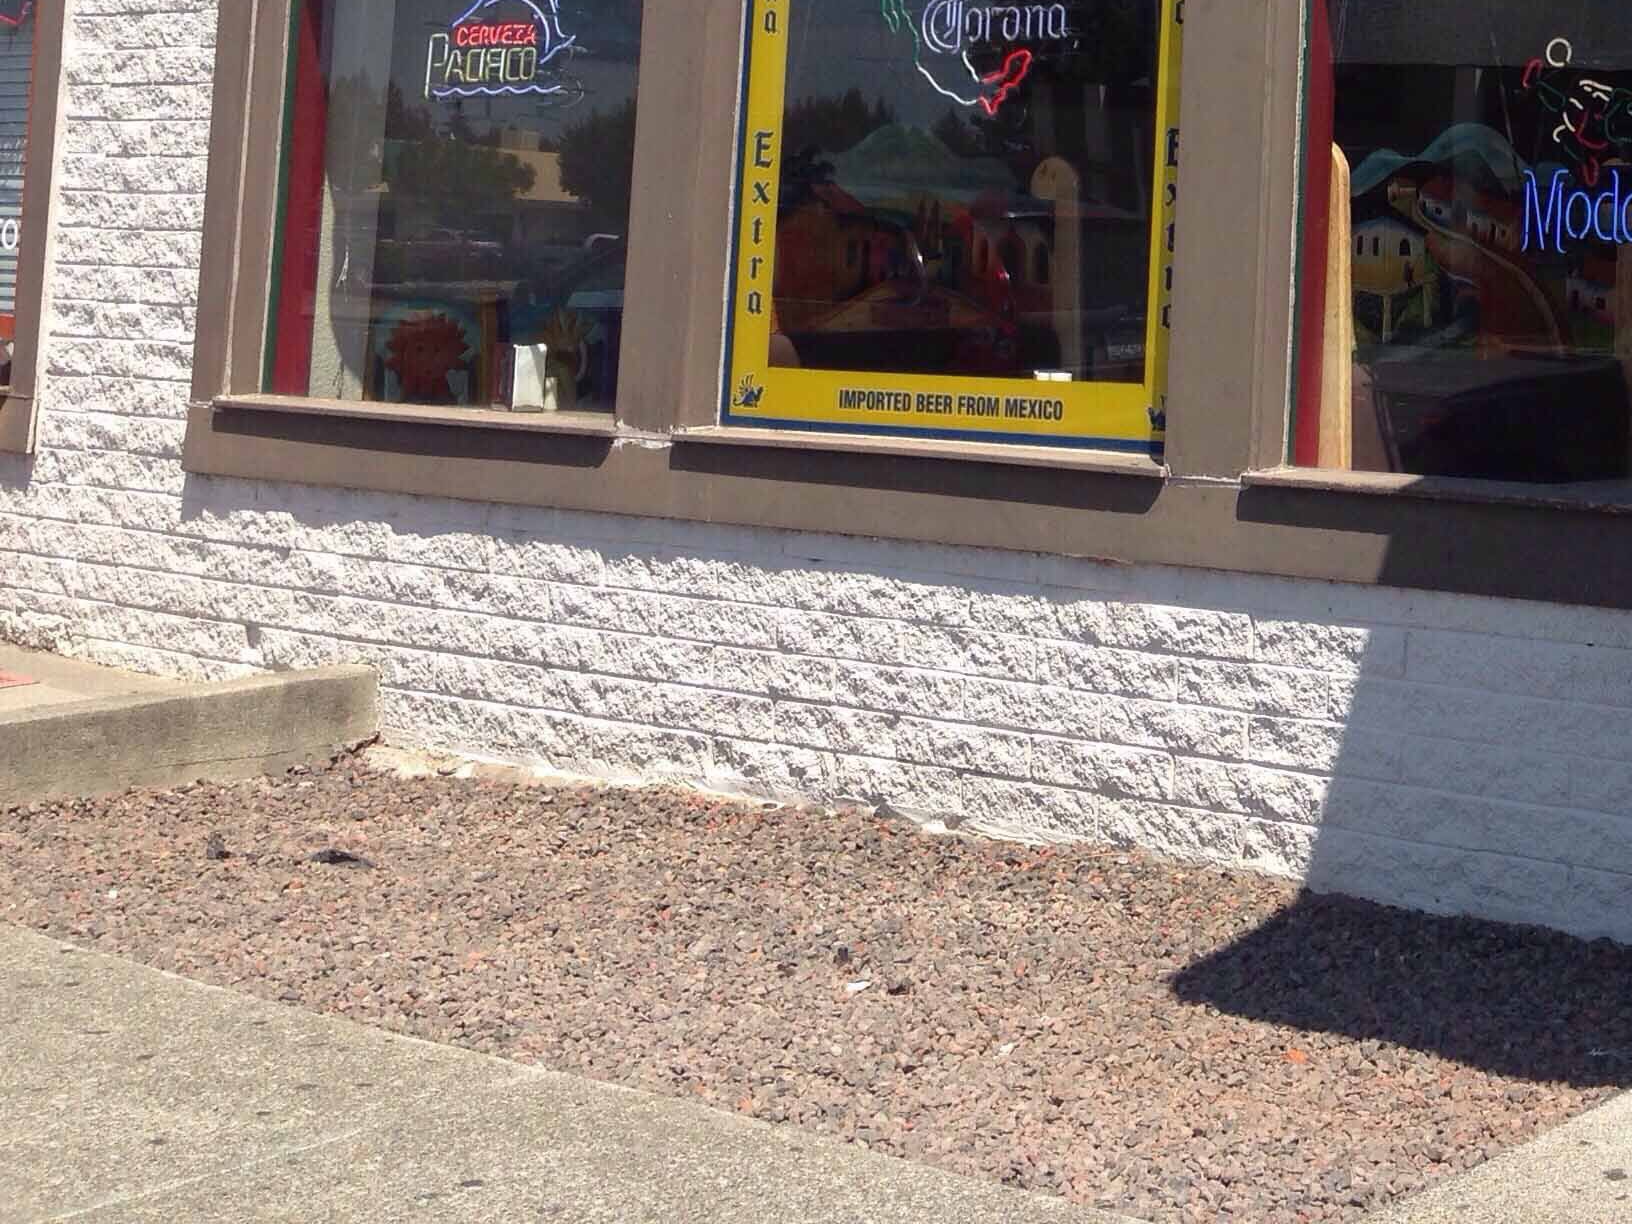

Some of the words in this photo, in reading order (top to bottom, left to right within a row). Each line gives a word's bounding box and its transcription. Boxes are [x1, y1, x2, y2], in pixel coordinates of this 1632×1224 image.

[456, 23, 537, 46] CERVEZA
[424, 32, 538, 99] PACIFICO
[747, 130, 774, 315] Extra
[838, 389, 912, 413] IMPORTED
[915, 392, 953, 416] BEER
[957, 395, 1001, 418] FROM
[1003, 397, 1064, 422] MEXICO
